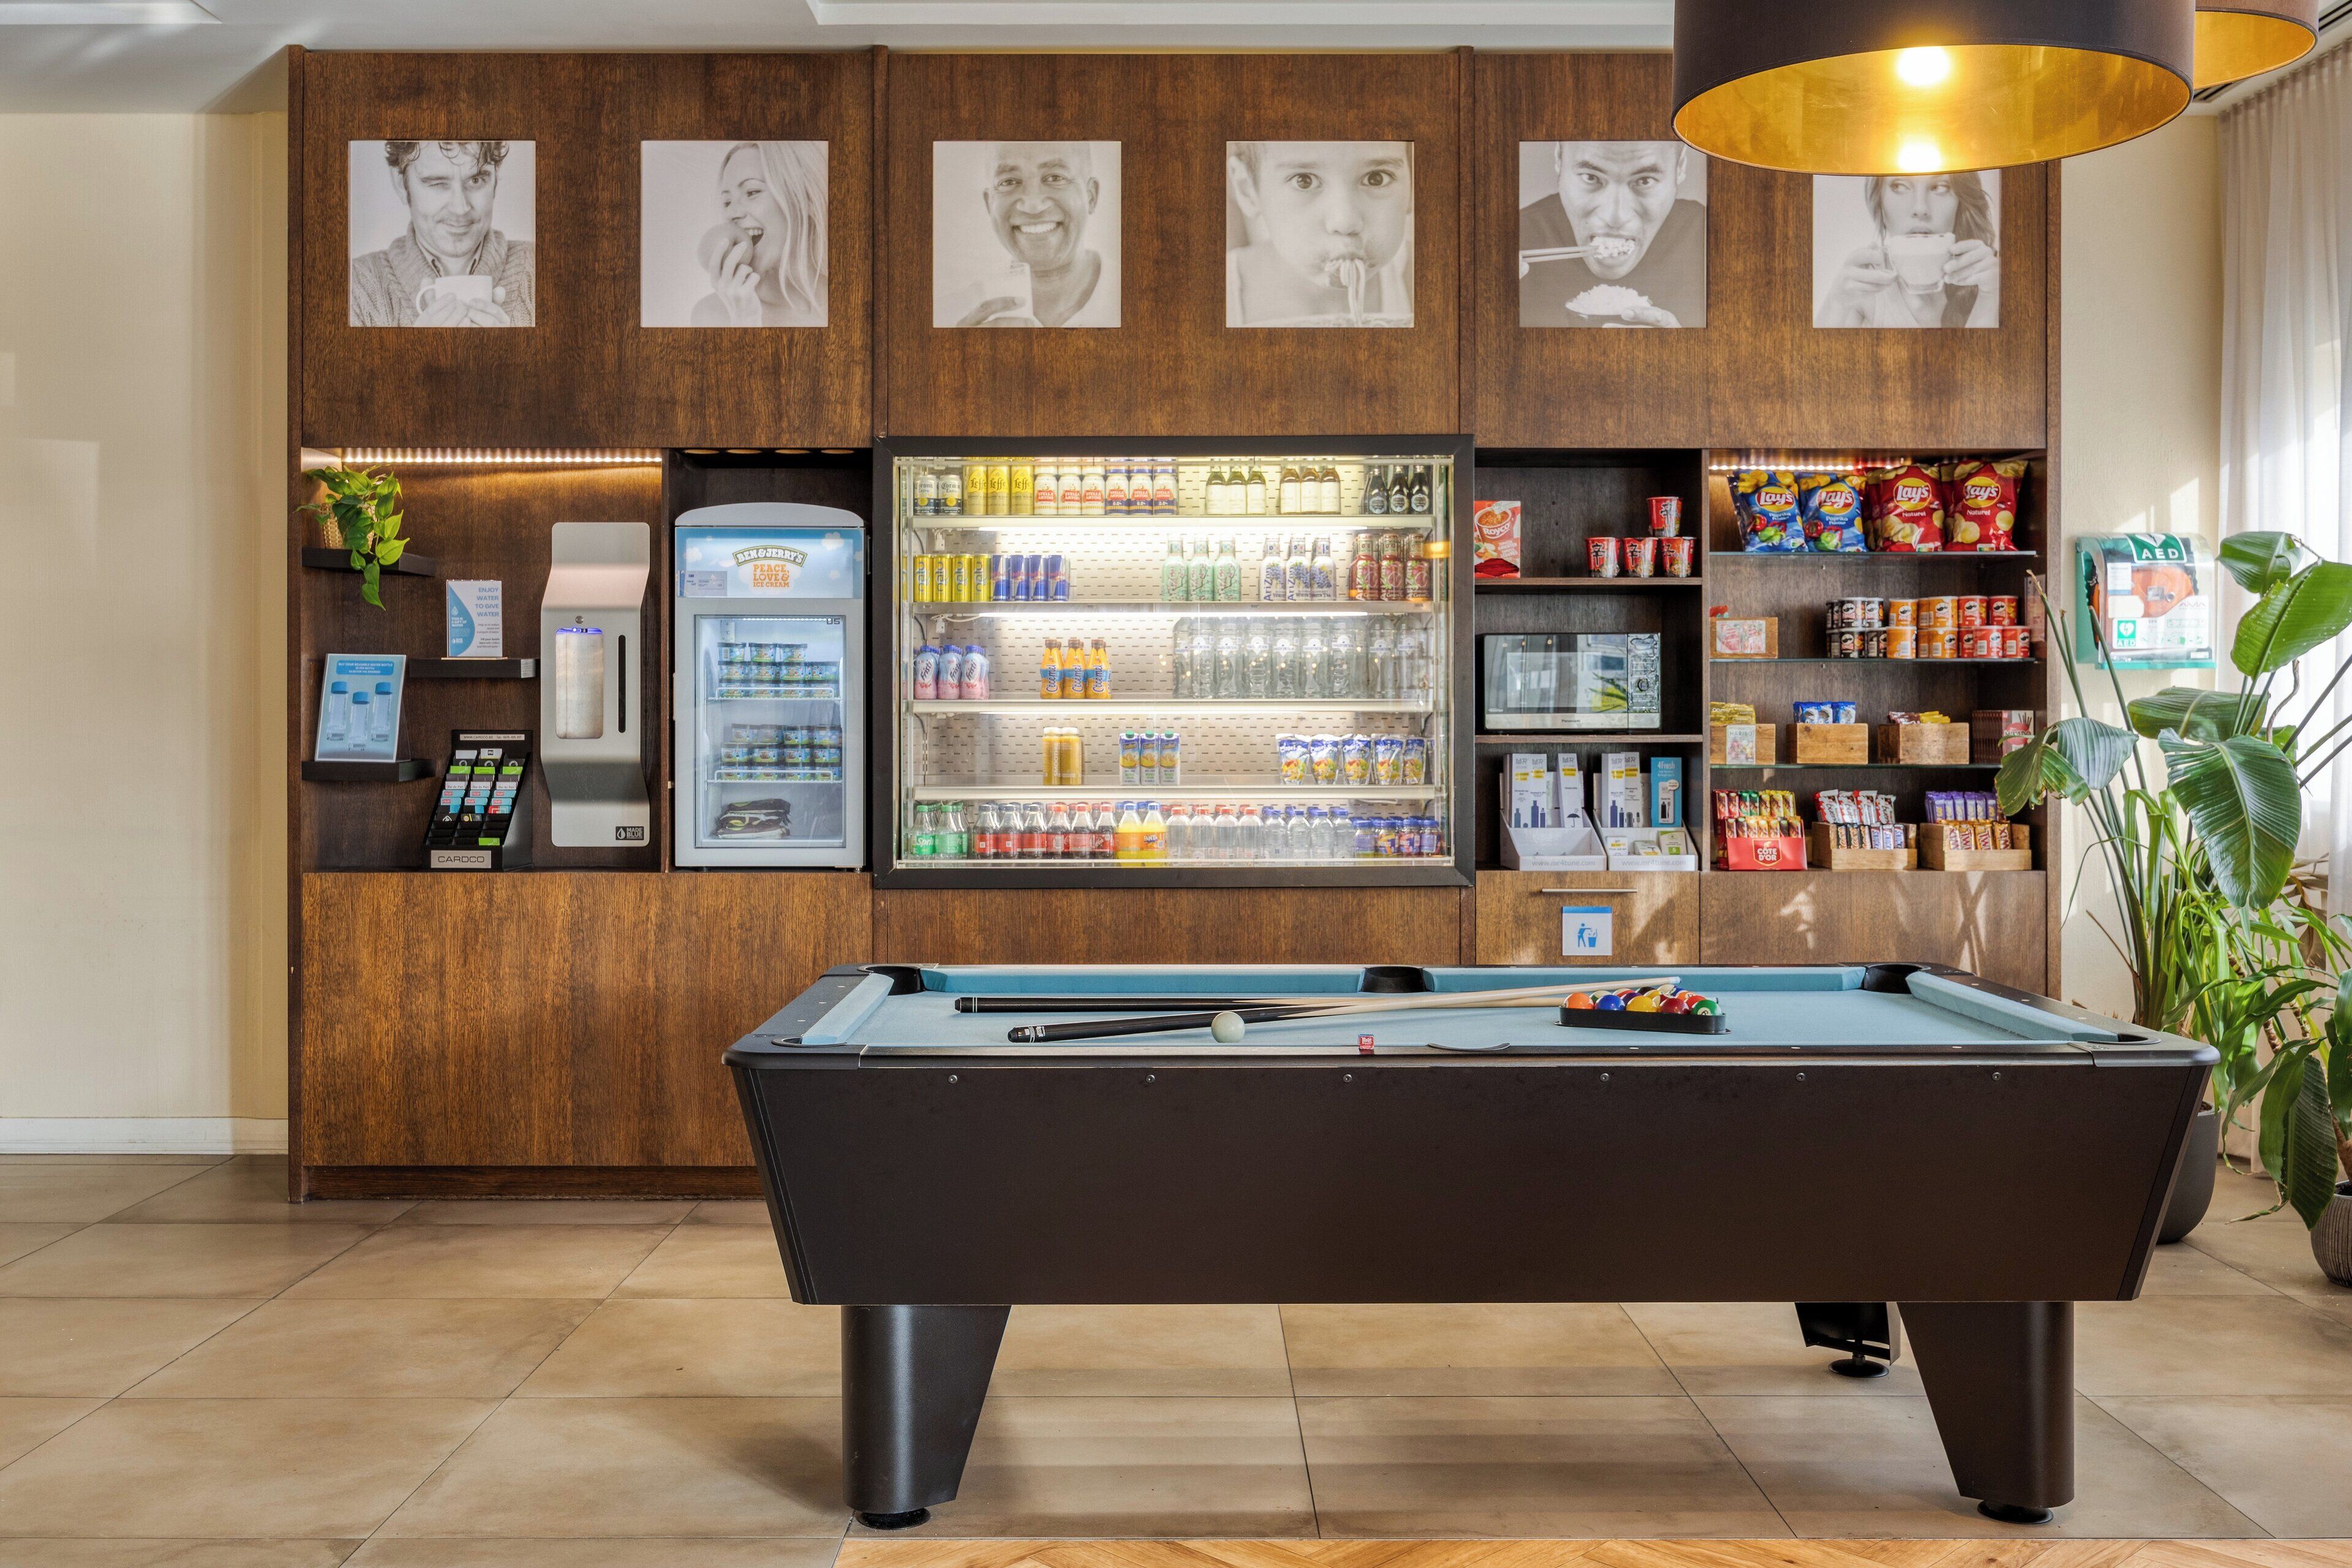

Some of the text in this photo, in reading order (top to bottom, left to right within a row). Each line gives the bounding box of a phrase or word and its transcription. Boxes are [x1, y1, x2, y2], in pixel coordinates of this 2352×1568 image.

[990, 478, 1005, 490] Leffe
[1760, 492, 1793, 505] Lay's
[1822, 491, 1853, 508] Lay's
[1897, 485, 1929, 503] Lay's
[1966, 485, 1999, 501] Lay's
[1483, 522, 1510, 536] Royco
[1591, 542, 1605, 567] 辛
[1627, 542, 1642, 567] 辛
[2142, 548, 2179, 559] AED
[753, 564, 790, 573] PEACE,
[753, 573, 789, 582] LOVE &
[920, 659, 932, 681] Fristi
[966, 660, 977, 681] Fristi
[1657, 761, 1675, 769] 4Fresh
[917, 837, 933, 847] Spri
